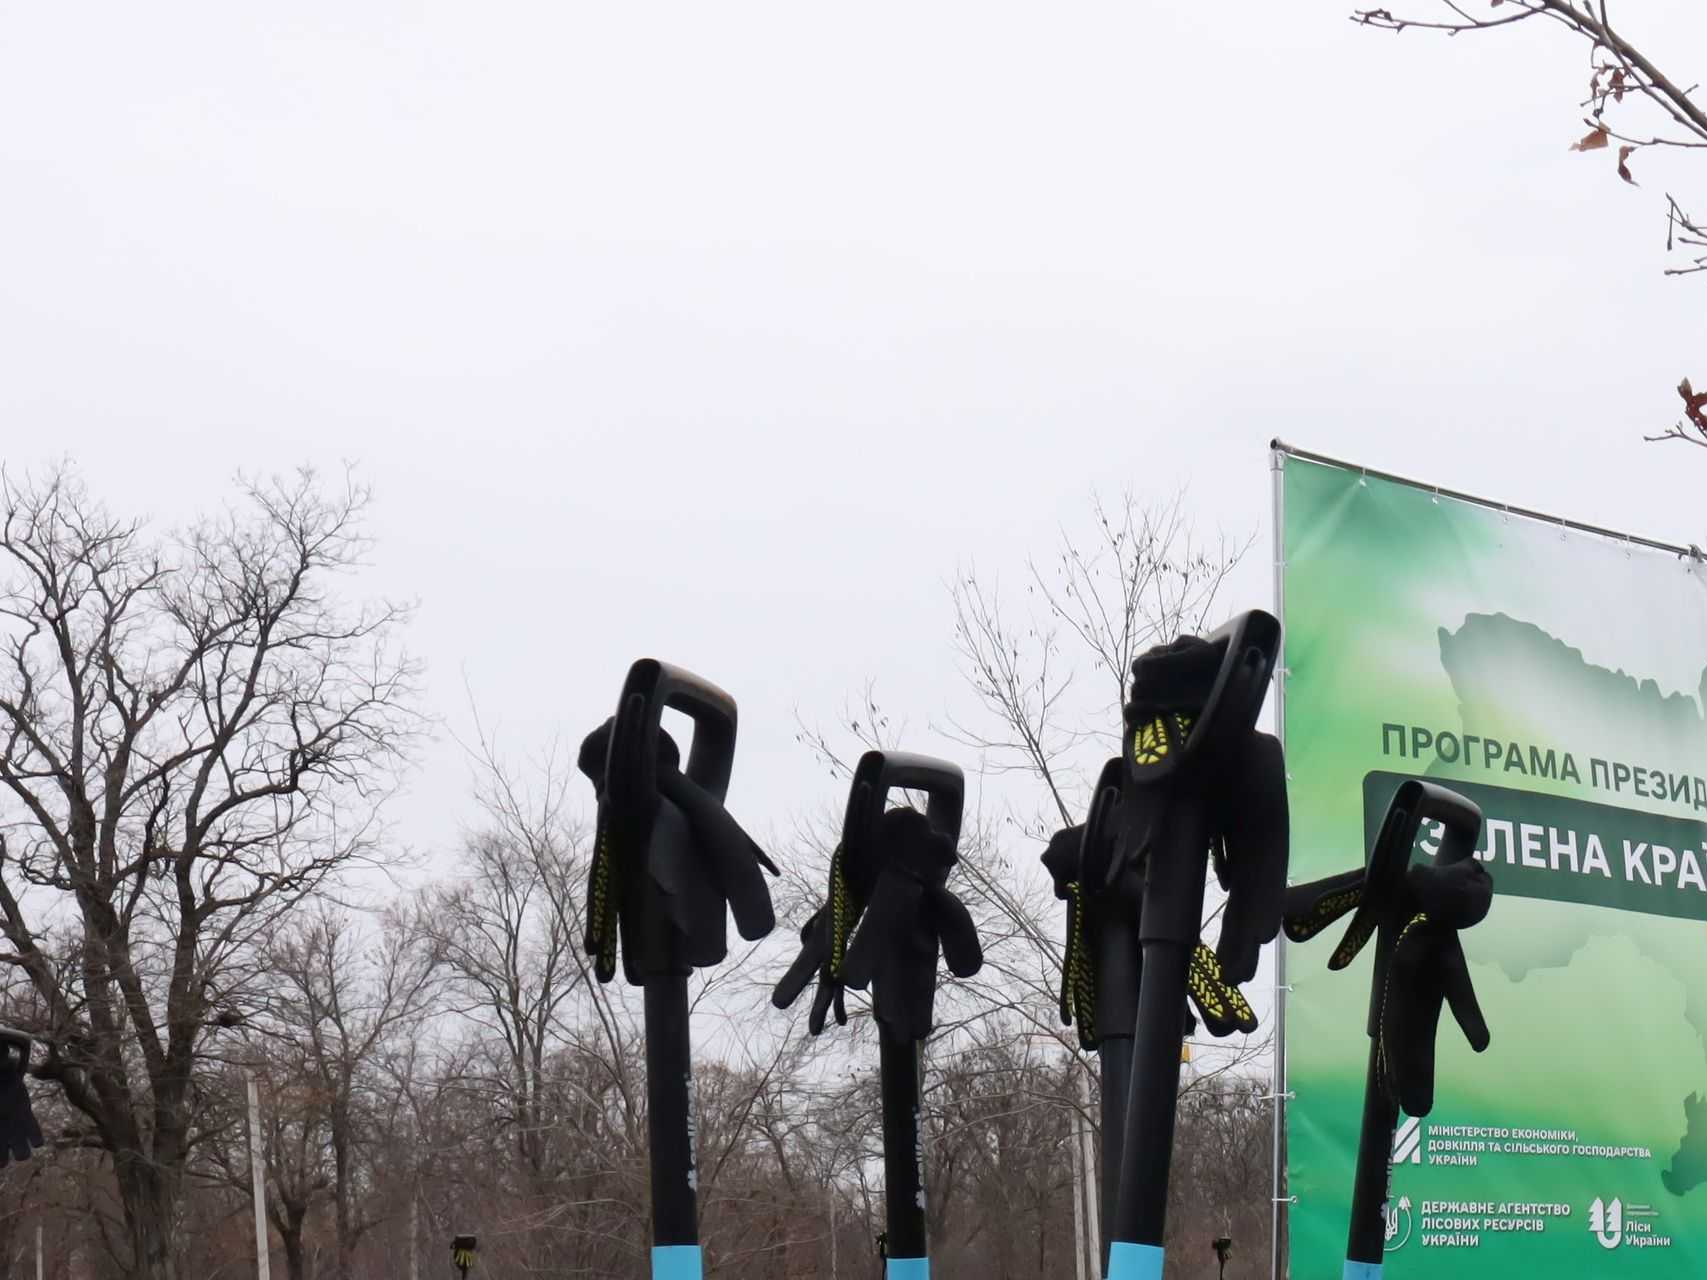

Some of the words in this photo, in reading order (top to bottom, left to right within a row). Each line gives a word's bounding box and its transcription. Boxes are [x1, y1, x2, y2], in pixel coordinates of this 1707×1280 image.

[1382, 722, 1581, 785] ПРОГРАМА
[1428, 1125, 1509, 1138] МІНІСТЕРСТВО
[1511, 1128, 1579, 1142] ЕКОНОМІКИ,
[1427, 1139, 1485, 1152] ДОВКІЛЛЯ
[1487, 1141, 1501, 1153] ТА
[1503, 1142, 1570, 1155] СІЛЬСЬКОГО
[1572, 1144, 1652, 1158] ГОСПОДАРСТВА
[1428, 1152, 1477, 1166] УКРАЇНИ
[1421, 1201, 1495, 1214] ДЕРЖАВНЕ
[1498, 1202, 1571, 1216] АГЕНТСТВО
[1421, 1218, 1480, 1231] ЛІСОВИХ
[1483, 1219, 1544, 1231] РЕСУРСІВ
[1625, 1220, 1651, 1233] Ліси
[1421, 1233, 1480, 1247] УКРАЇНИ
[1625, 1234, 1671, 1248] України
